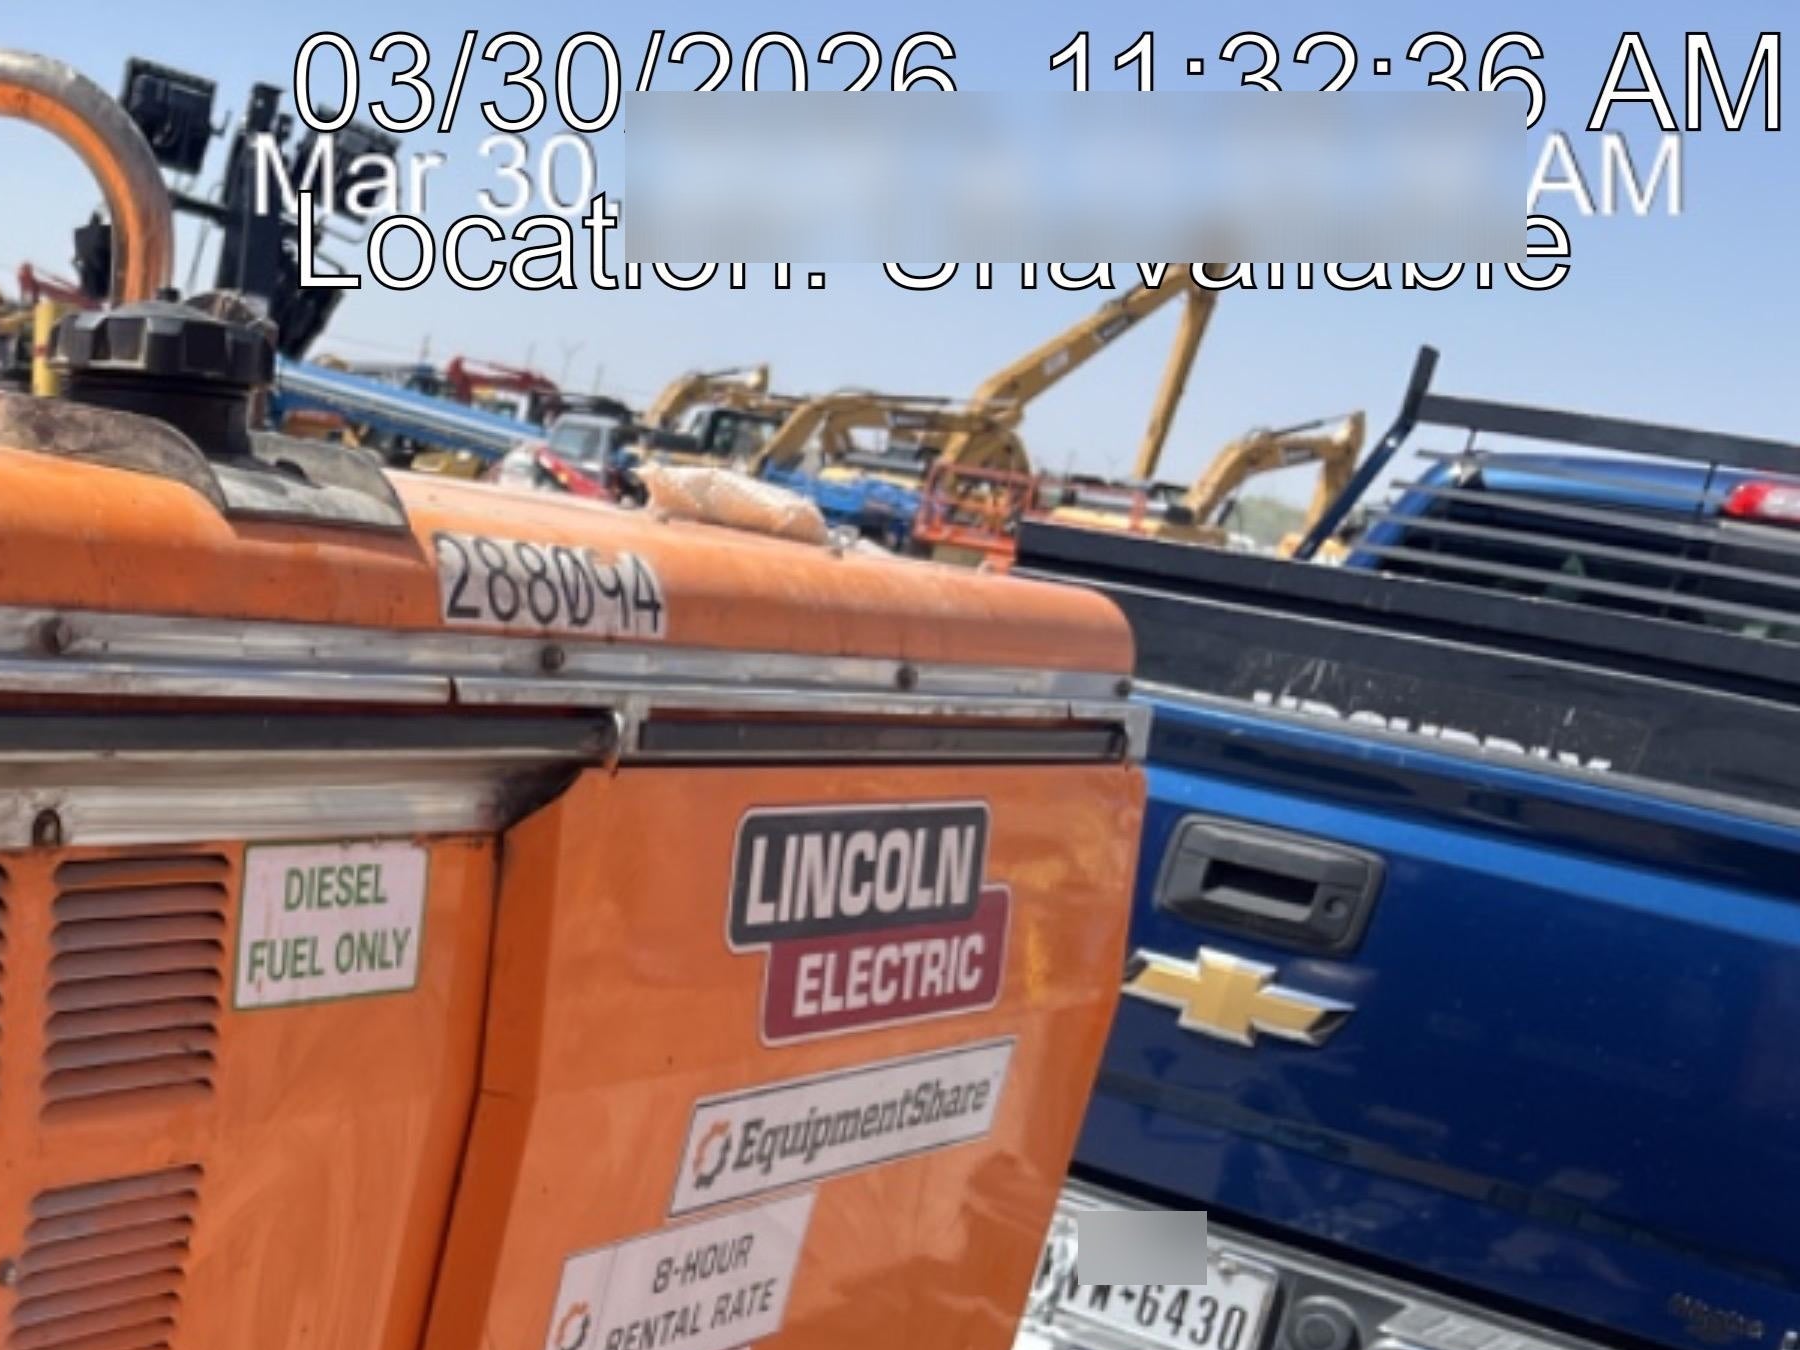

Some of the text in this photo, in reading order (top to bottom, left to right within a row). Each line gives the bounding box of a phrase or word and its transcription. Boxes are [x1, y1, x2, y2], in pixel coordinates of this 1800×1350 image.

[283, 863, 389, 912] DIESEL
[743, 824, 978, 927] LINCOLN
[246, 925, 412, 985] FUEL ONLY
[791, 932, 987, 1019] ELECTRIC
[731, 1070, 995, 1176] EquipmentShare
[652, 1233, 755, 1294] 8-HOUR
[709, 1277, 779, 1330] RATE
